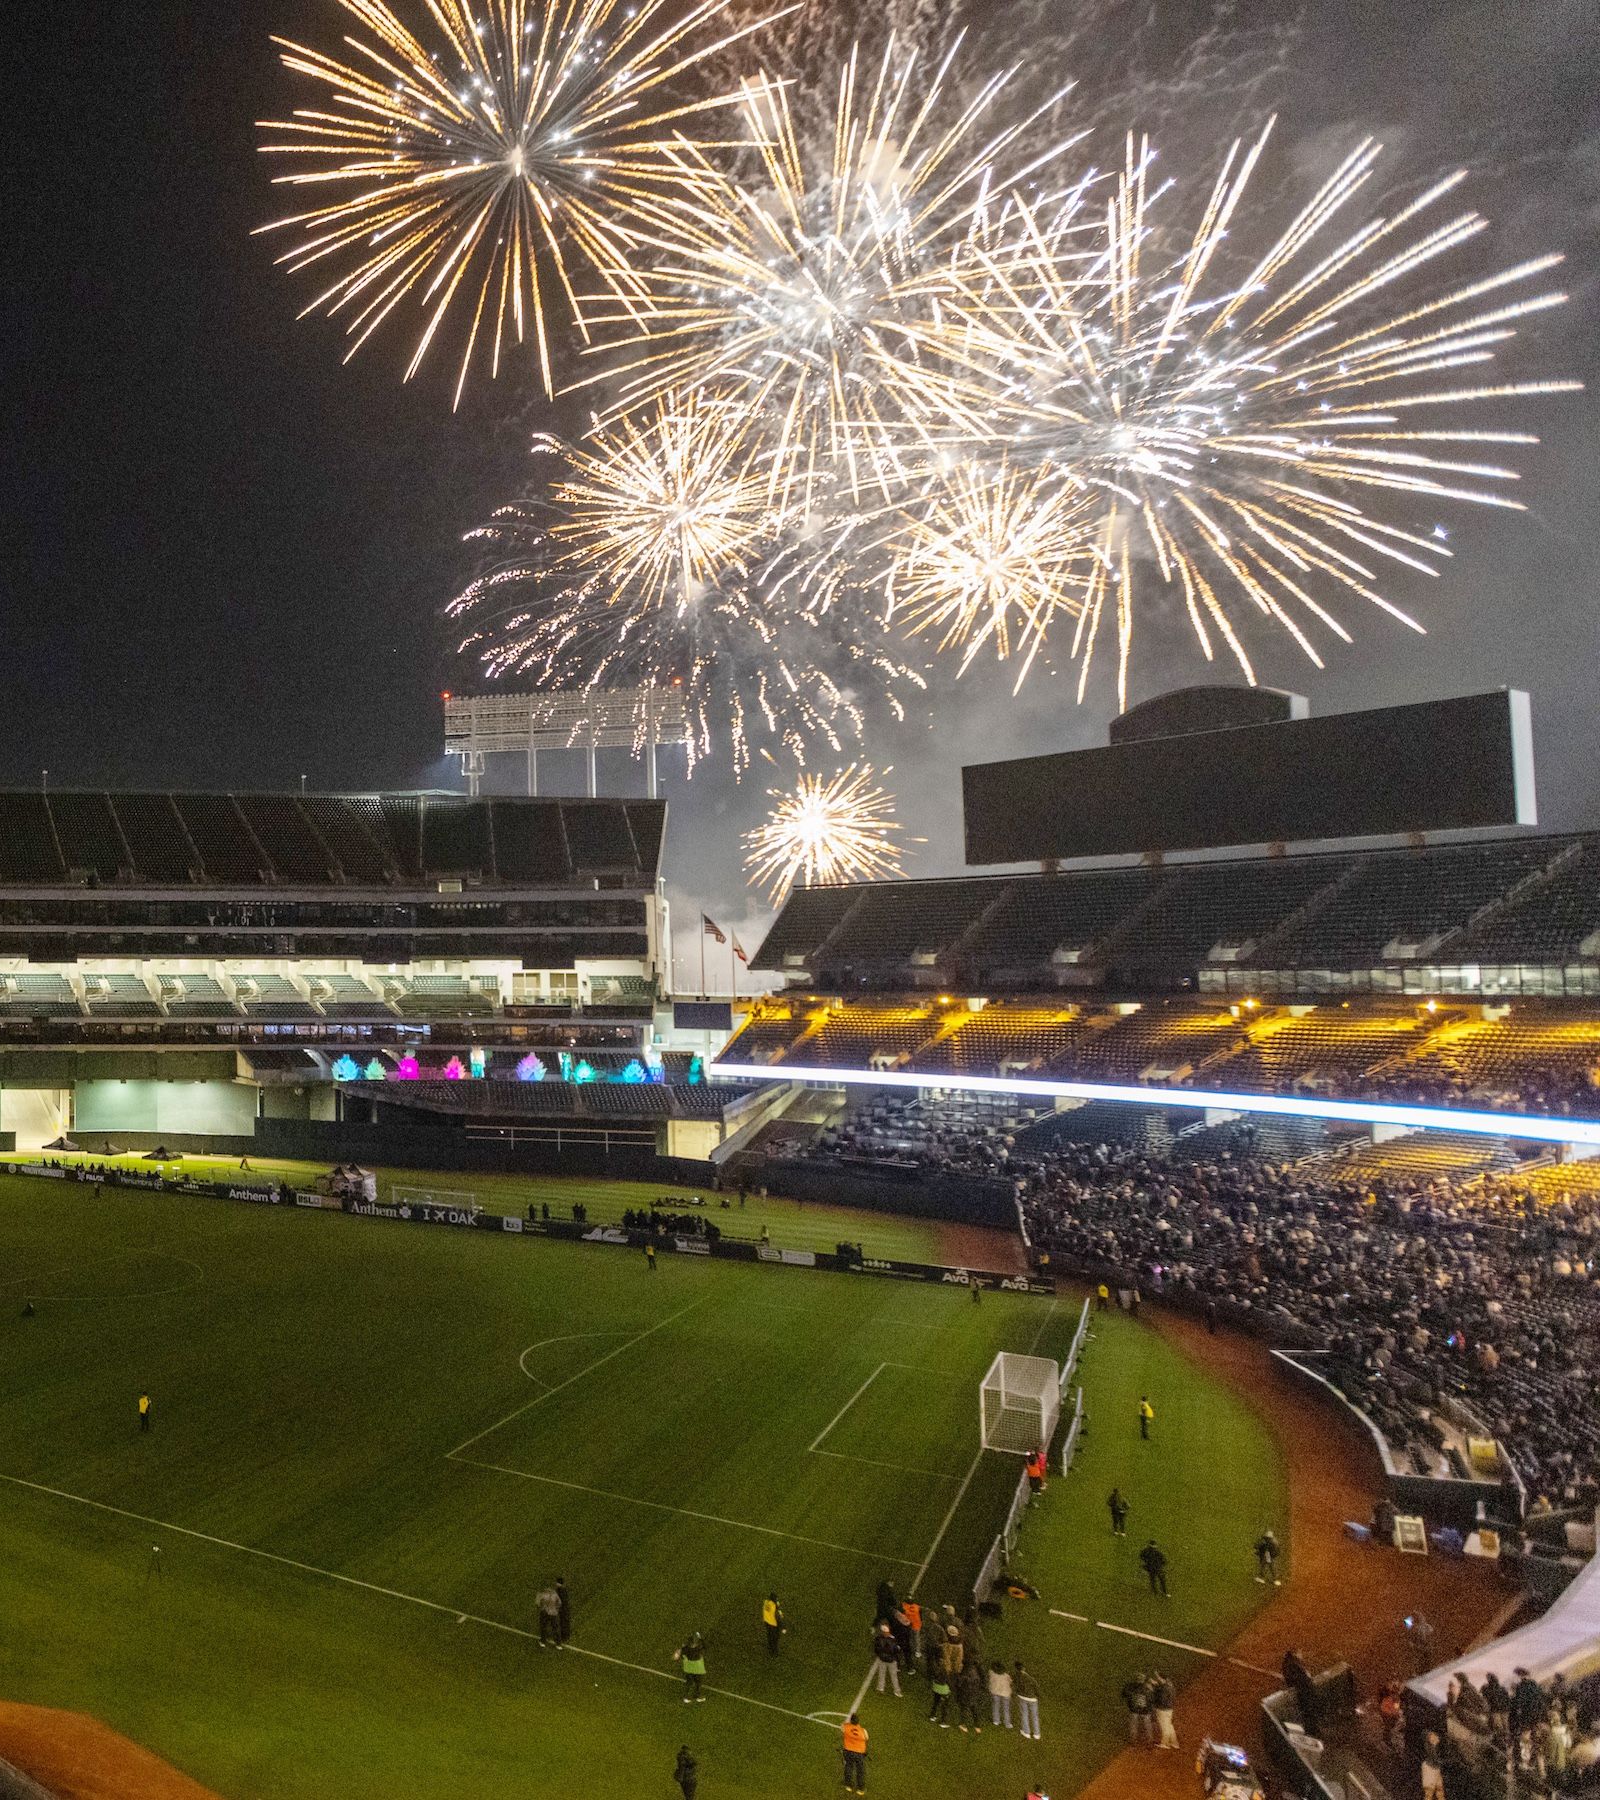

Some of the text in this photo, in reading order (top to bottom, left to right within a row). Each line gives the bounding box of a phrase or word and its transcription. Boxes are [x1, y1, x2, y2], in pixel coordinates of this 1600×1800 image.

[229, 1189, 269, 1202] Anthem
[351, 1201, 397, 1218] Anthem
[449, 1211, 477, 1226] OAK
[943, 1271, 969, 1285] Ava
[1001, 1278, 1029, 1291] Ava
